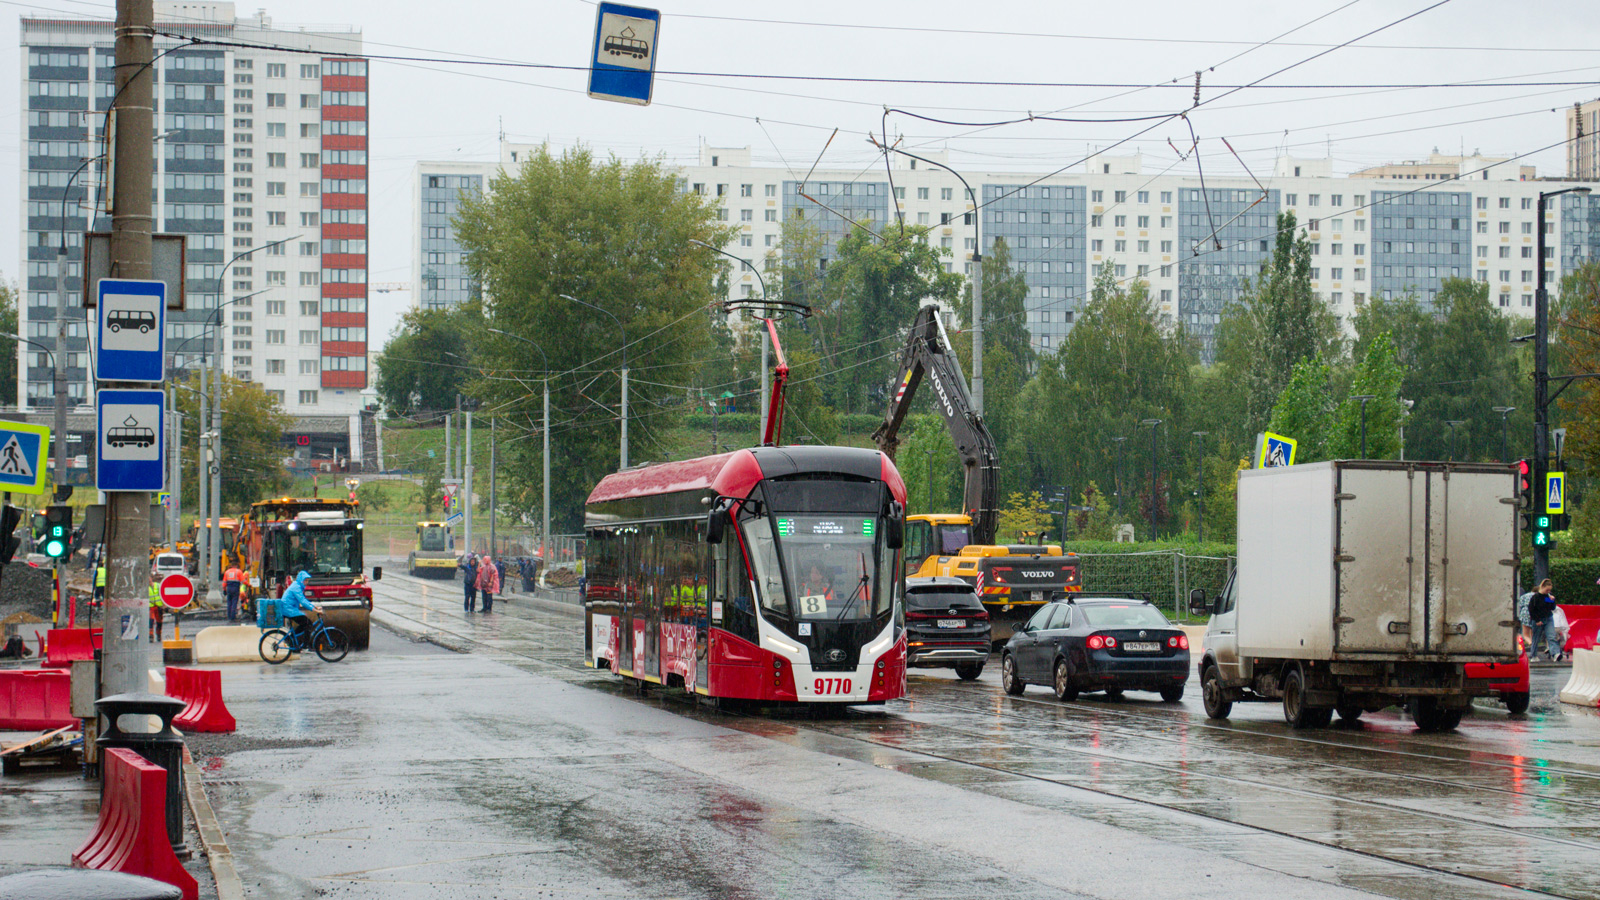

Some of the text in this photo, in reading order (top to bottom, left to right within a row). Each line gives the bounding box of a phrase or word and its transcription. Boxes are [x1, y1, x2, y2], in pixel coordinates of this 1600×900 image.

[931, 366, 954, 418] VOLVO
[1539, 517, 1549, 527] 13
[53, 526, 63, 537] 13
[806, 597, 820, 613] 8
[814, 678, 852, 695] 9770
